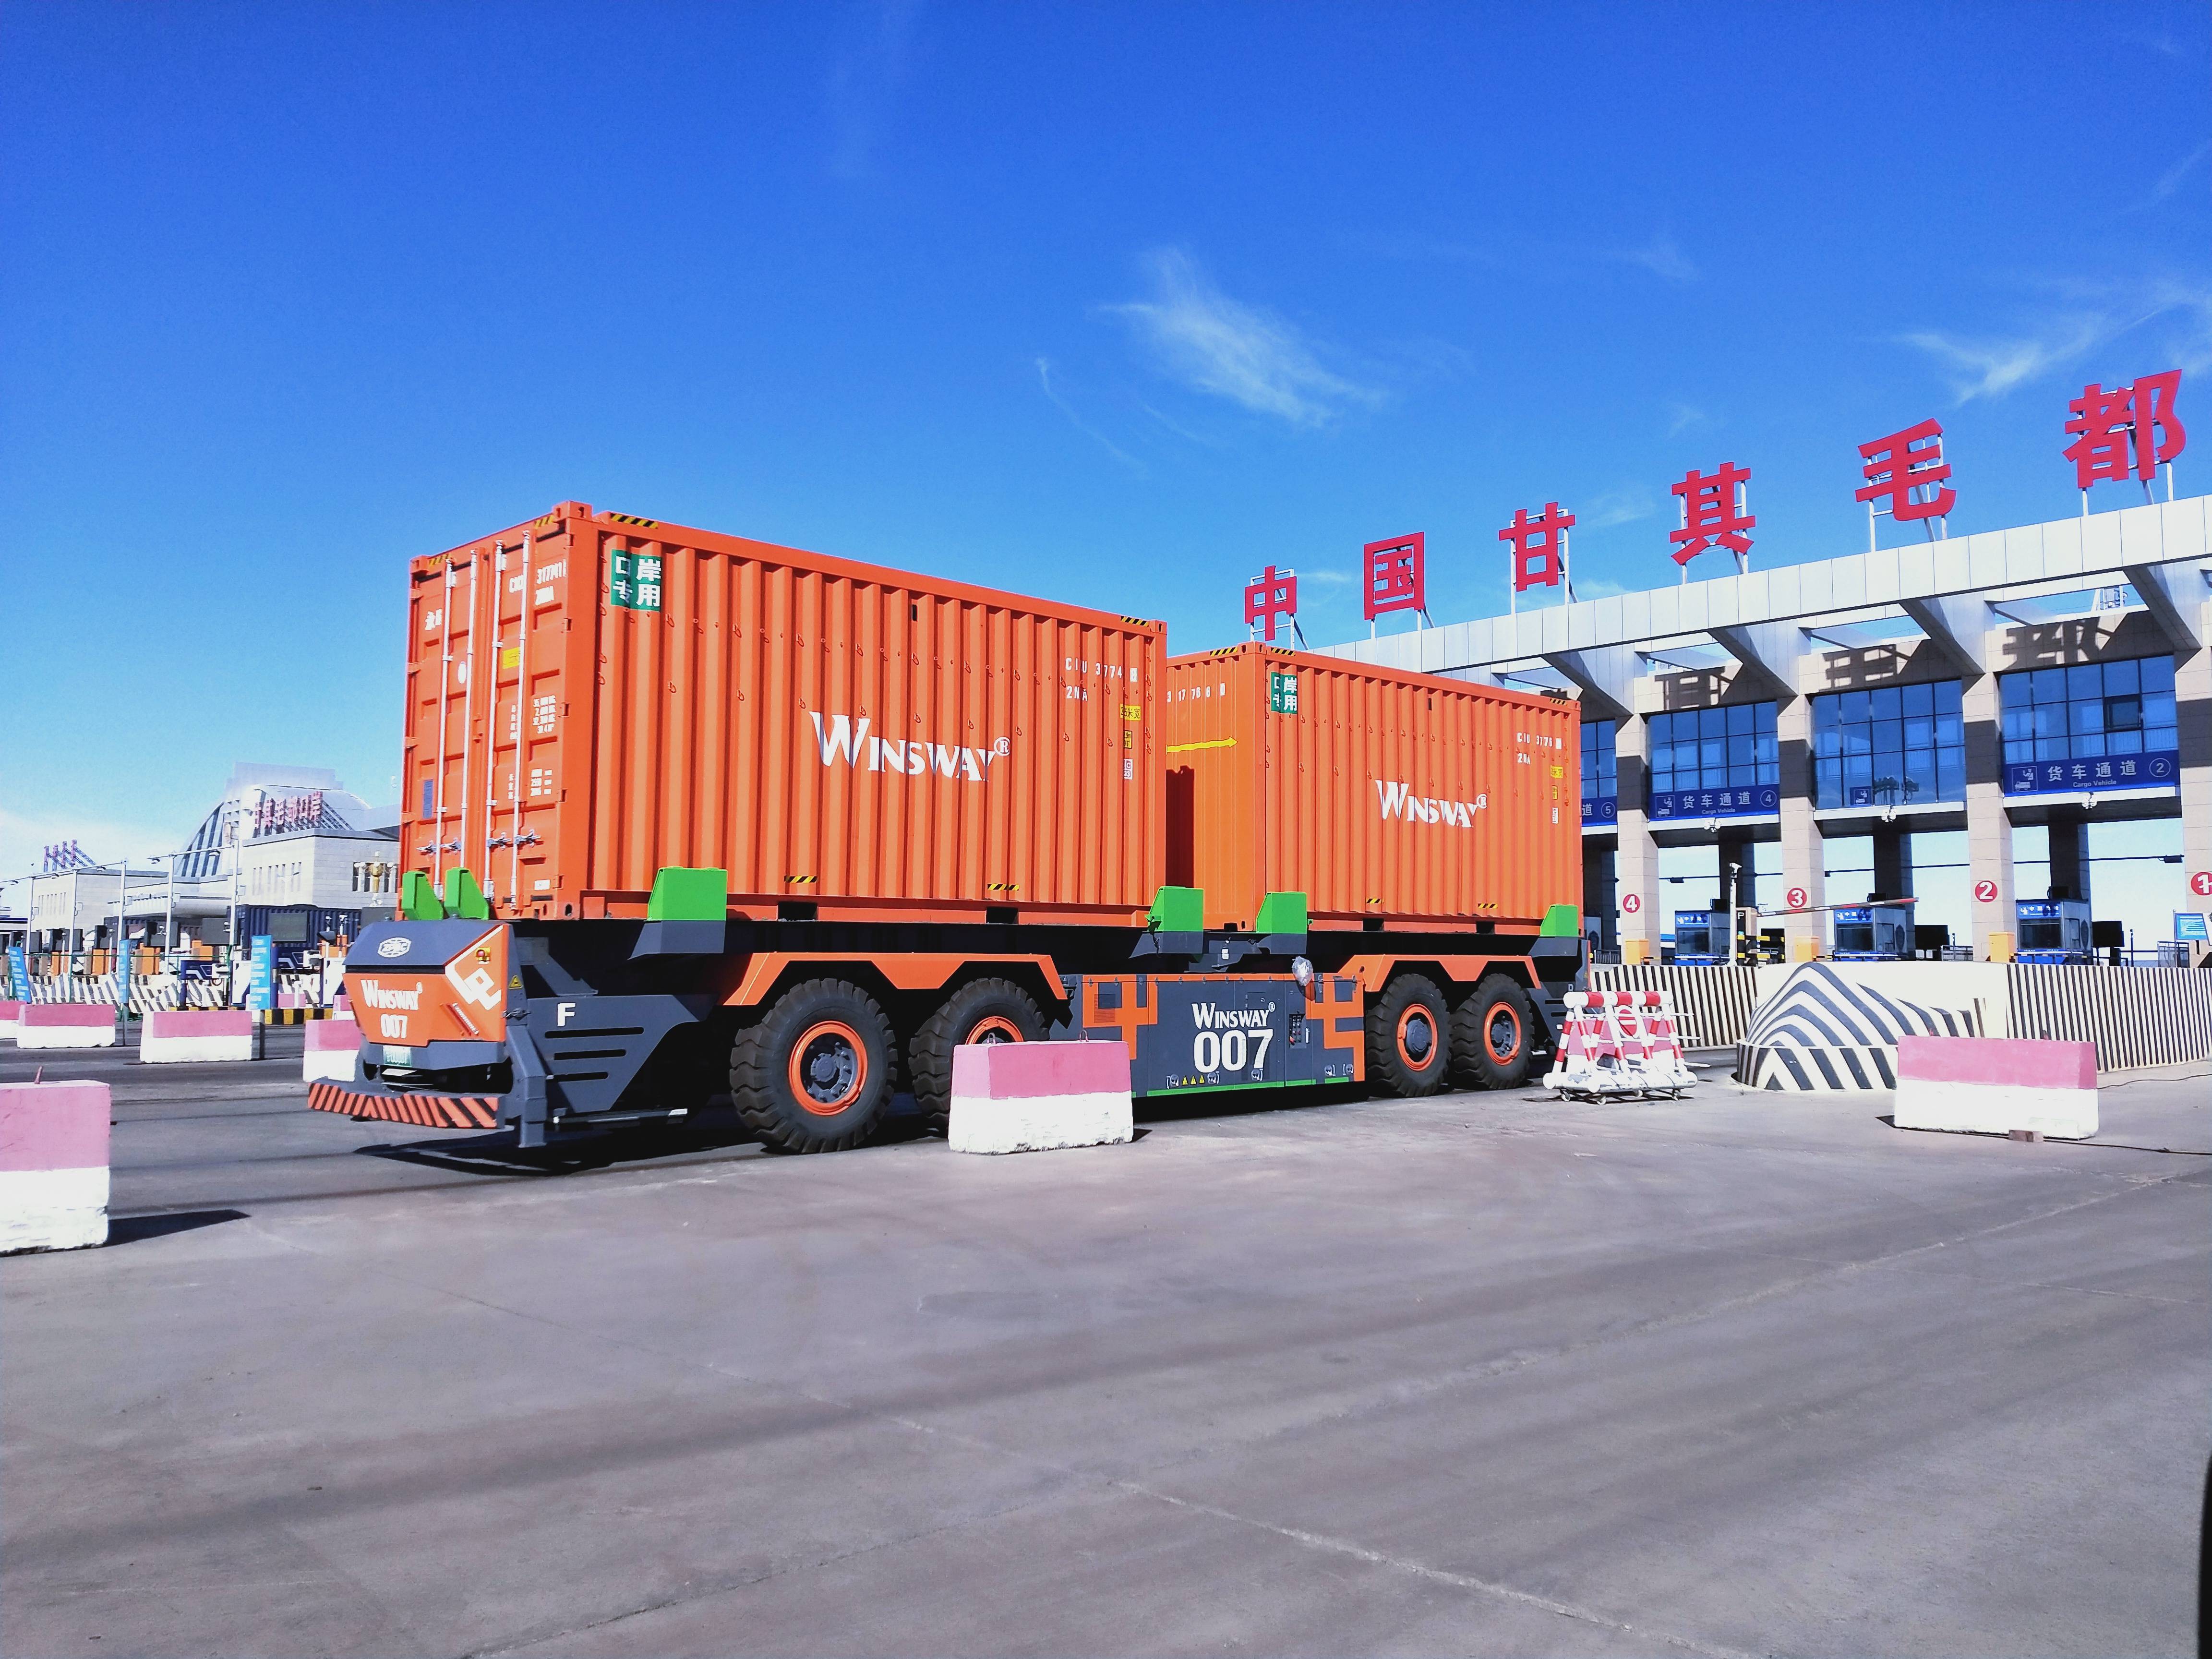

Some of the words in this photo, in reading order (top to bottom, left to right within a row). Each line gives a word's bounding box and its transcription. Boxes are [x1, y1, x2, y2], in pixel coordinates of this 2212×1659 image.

[1244, 369, 2187, 641] 中国甘其毛都
[615, 555, 661, 582] 口岸
[613, 579, 661, 607] 专用
[1095, 662, 1122, 678] 3774
[2047, 760, 2136, 781] 货车通道
[1683, 791, 1751, 809] 货车通道
[1791, 889, 1803, 906] 3
[1979, 881, 1993, 900] 2
[1625, 895, 1638, 911] 4
[381, 1013, 408, 1039] 007
[557, 1003, 576, 1027] F
[1194, 1029, 1274, 1073] 007
